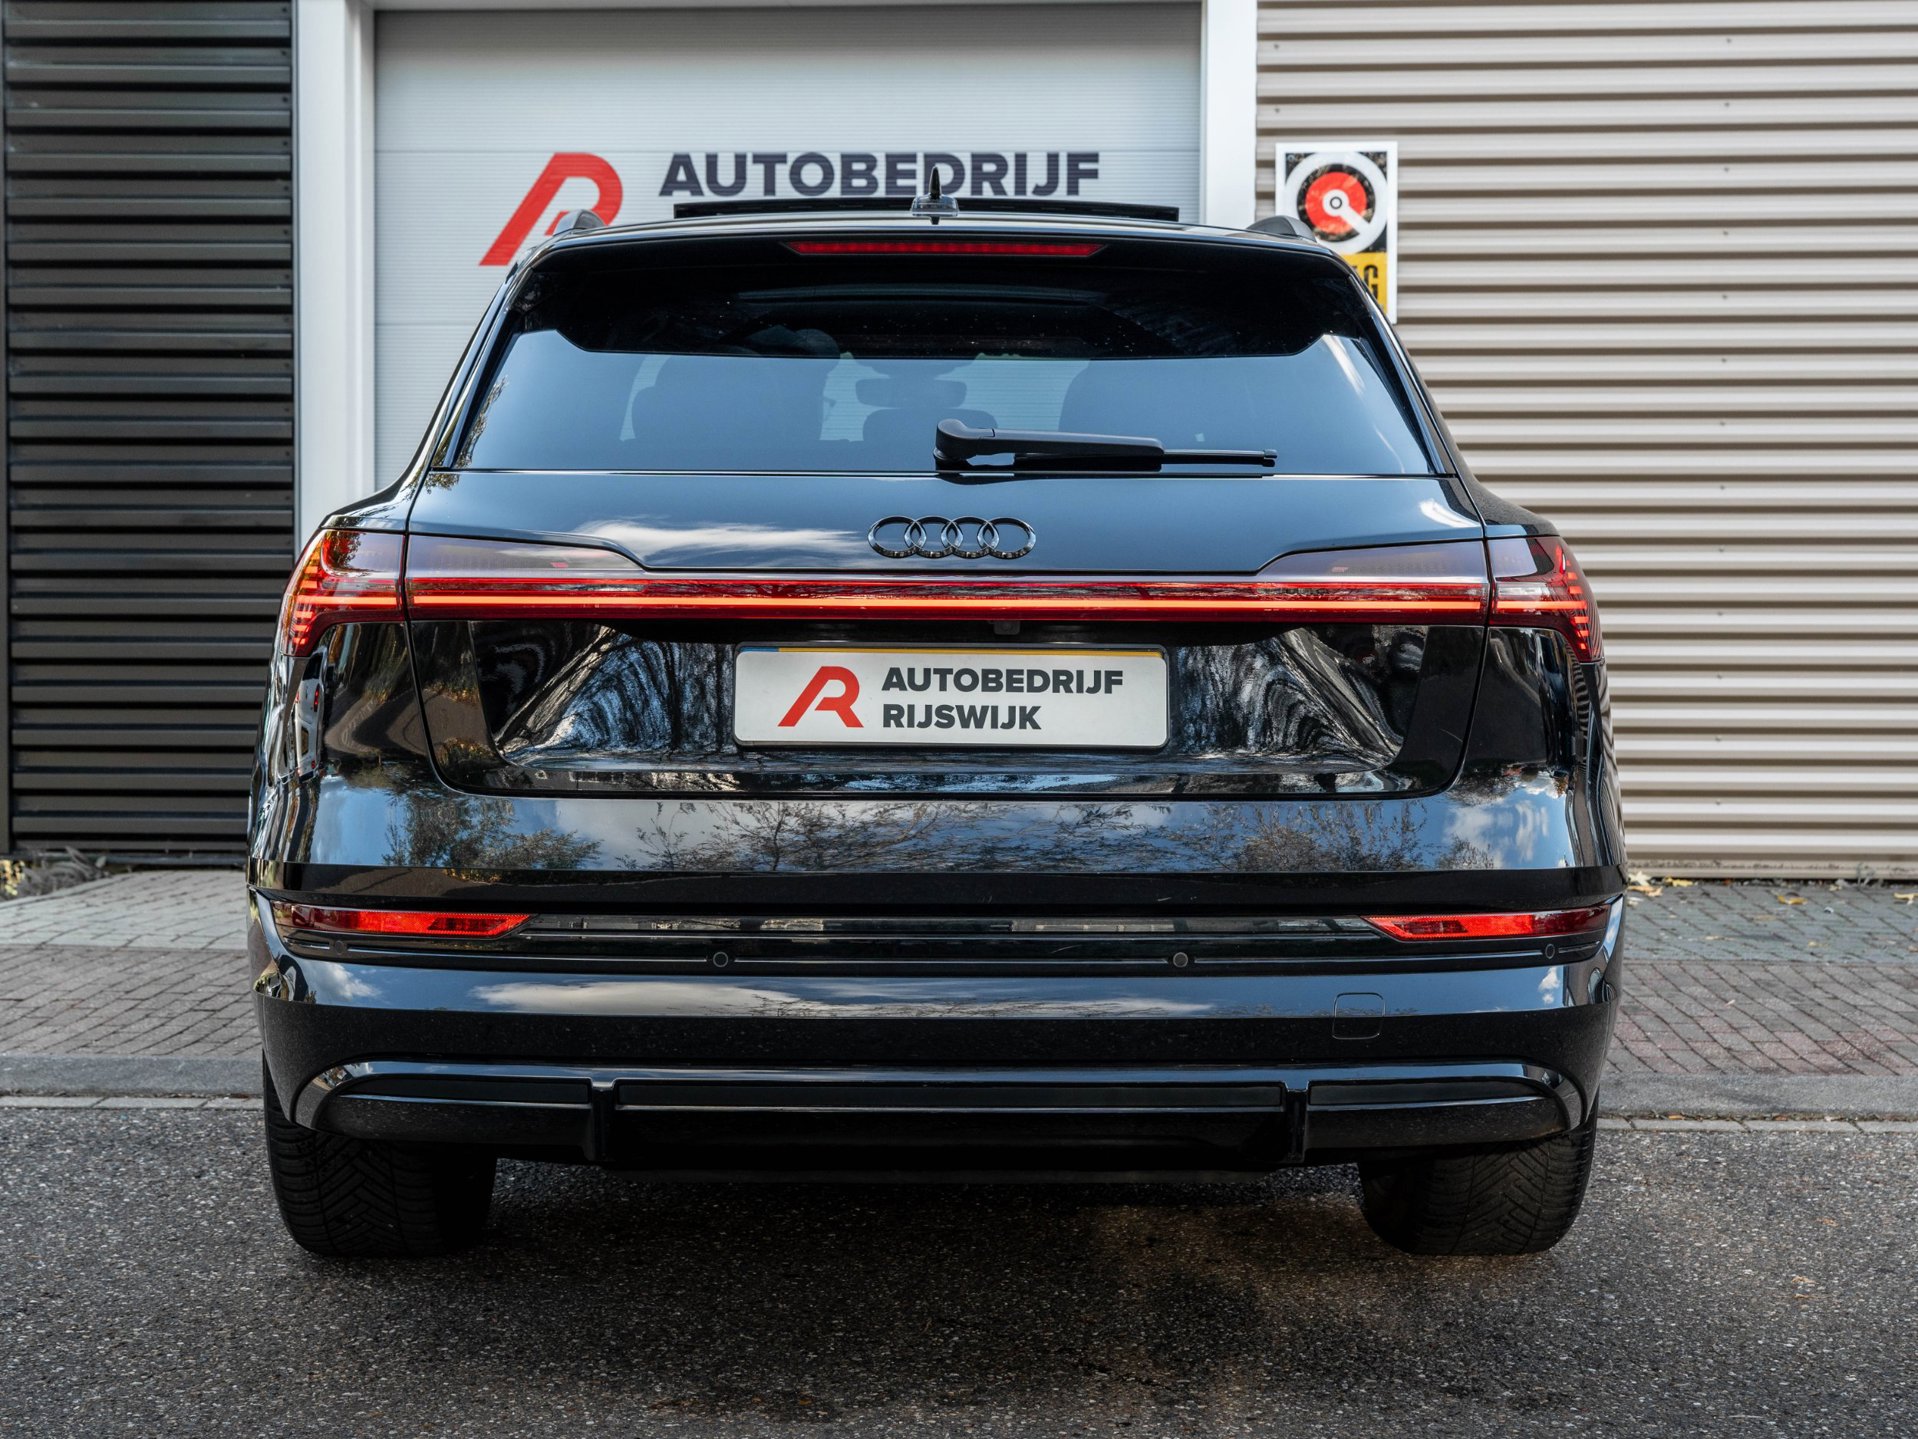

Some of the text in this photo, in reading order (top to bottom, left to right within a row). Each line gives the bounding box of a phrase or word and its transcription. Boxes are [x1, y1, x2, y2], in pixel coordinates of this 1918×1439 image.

[659, 152, 1100, 197] AUTOBEDRIJF
[882, 667, 1124, 694] AUTOBEDRIJF
[882, 704, 1042, 730] RIJSWIJK
